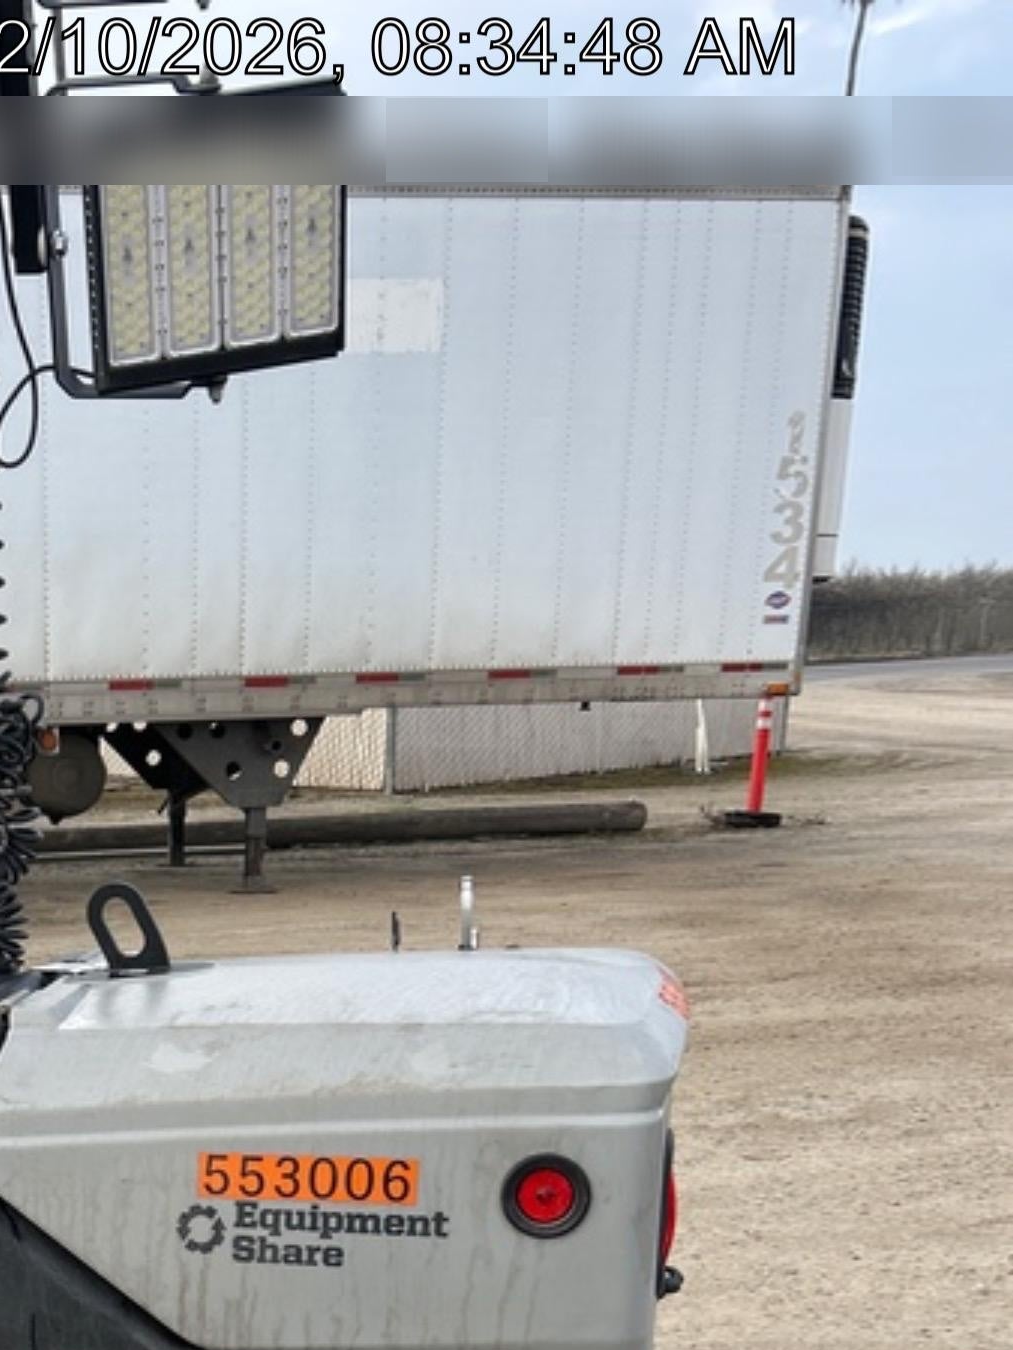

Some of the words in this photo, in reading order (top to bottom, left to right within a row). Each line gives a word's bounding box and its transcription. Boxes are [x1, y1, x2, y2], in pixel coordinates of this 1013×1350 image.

[203, 1154, 411, 1202] 553006
[234, 1201, 450, 1239] Equipment
[232, 1236, 344, 1267] Share
